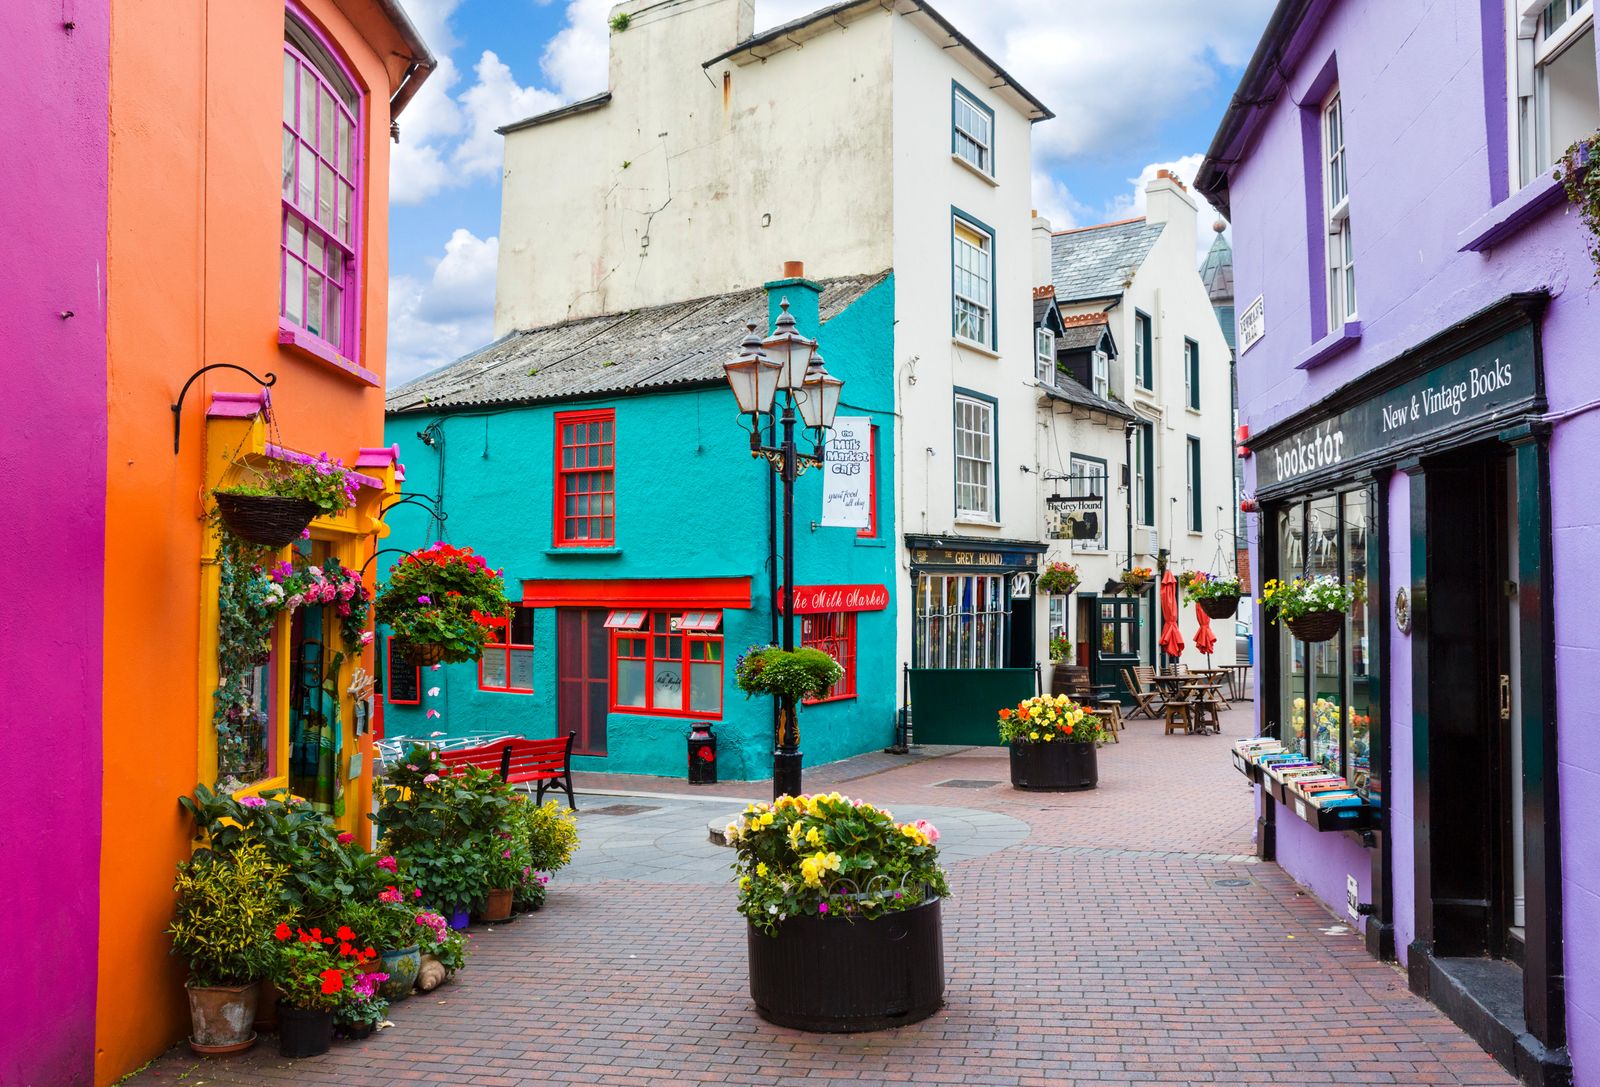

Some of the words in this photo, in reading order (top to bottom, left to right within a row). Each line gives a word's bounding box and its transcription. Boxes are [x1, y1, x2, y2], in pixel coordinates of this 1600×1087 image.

[1382, 404, 1408, 433] New
[1410, 394, 1420, 421] &
[1421, 387, 1468, 416] Vintage
[1469, 358, 1512, 399] Books
[833, 439, 861, 451] Milk
[825, 450, 870, 462] Market
[1047, 502, 1061, 512] The
[1060, 501, 1078, 511] Grey
[1078, 500, 1102, 510] Hound
[955, 551, 975, 565] GREY
[979, 552, 1003, 565] HOUND
[811, 589, 843, 609] Milk
[845, 588, 885, 607] Market
